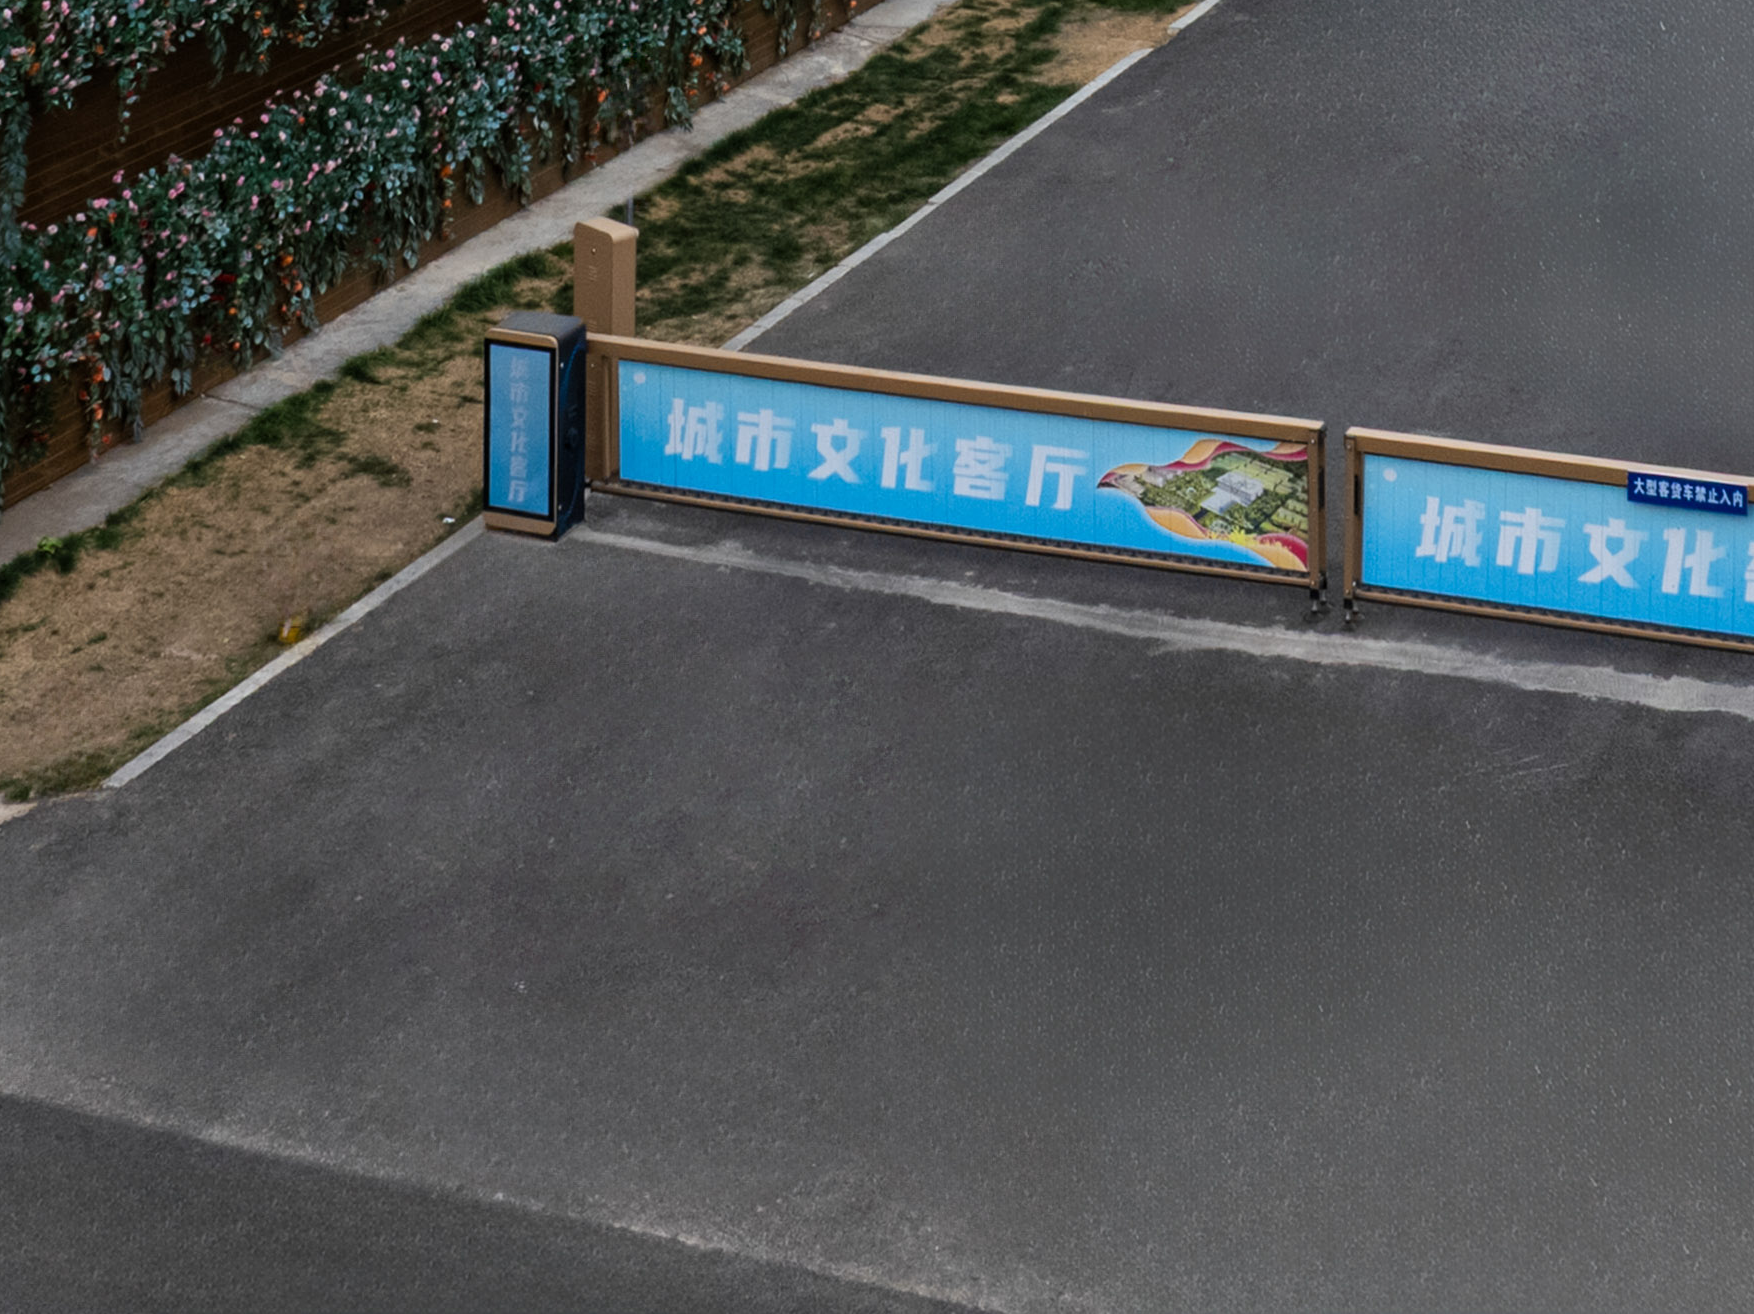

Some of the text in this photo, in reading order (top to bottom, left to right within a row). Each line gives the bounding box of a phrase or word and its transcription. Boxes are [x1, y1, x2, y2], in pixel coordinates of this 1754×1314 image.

[664, 398, 1090, 510] 城市文化客厅
[1633, 477, 1744, 508] 大型客货车禁止入内
